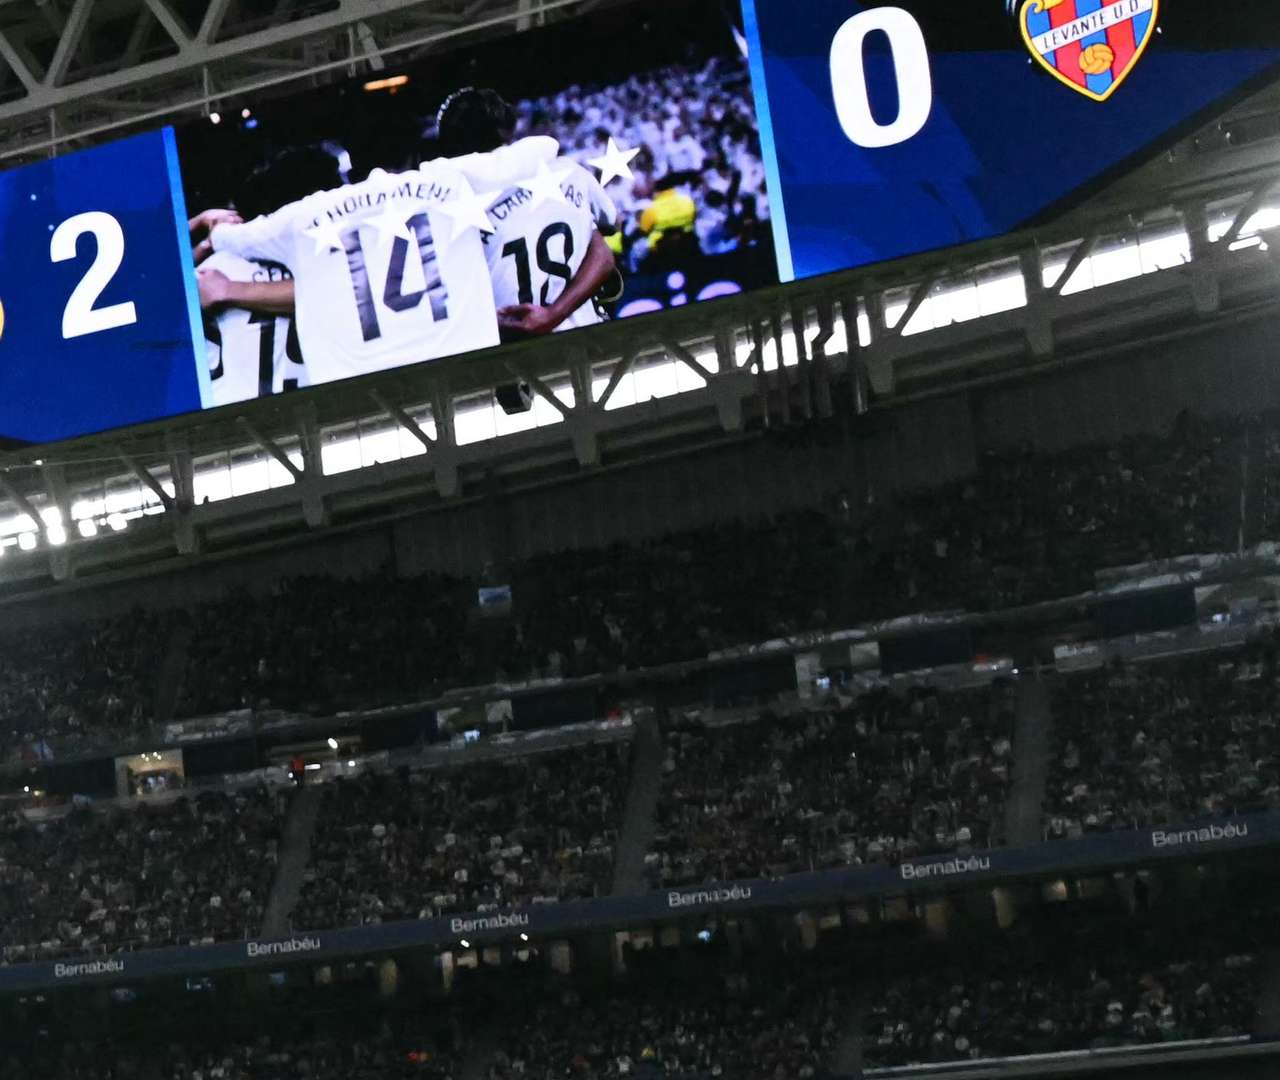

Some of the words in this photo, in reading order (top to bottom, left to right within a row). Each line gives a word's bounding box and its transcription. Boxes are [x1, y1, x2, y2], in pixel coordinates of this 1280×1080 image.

[1043, 10, 1106, 49] LEVANTE
[829, 6, 933, 148] 0
[51, 211, 138, 340] 2
[329, 212, 449, 343] 14
[502, 221, 574, 307] 18
[1151, 822, 1248, 848] Bernabéu
[901, 855, 991, 880] Bernabéu
[451, 912, 530, 934] Bernabéu
[247, 936, 321, 957] Bernabéu
[54, 959, 125, 978] Bernabéu
